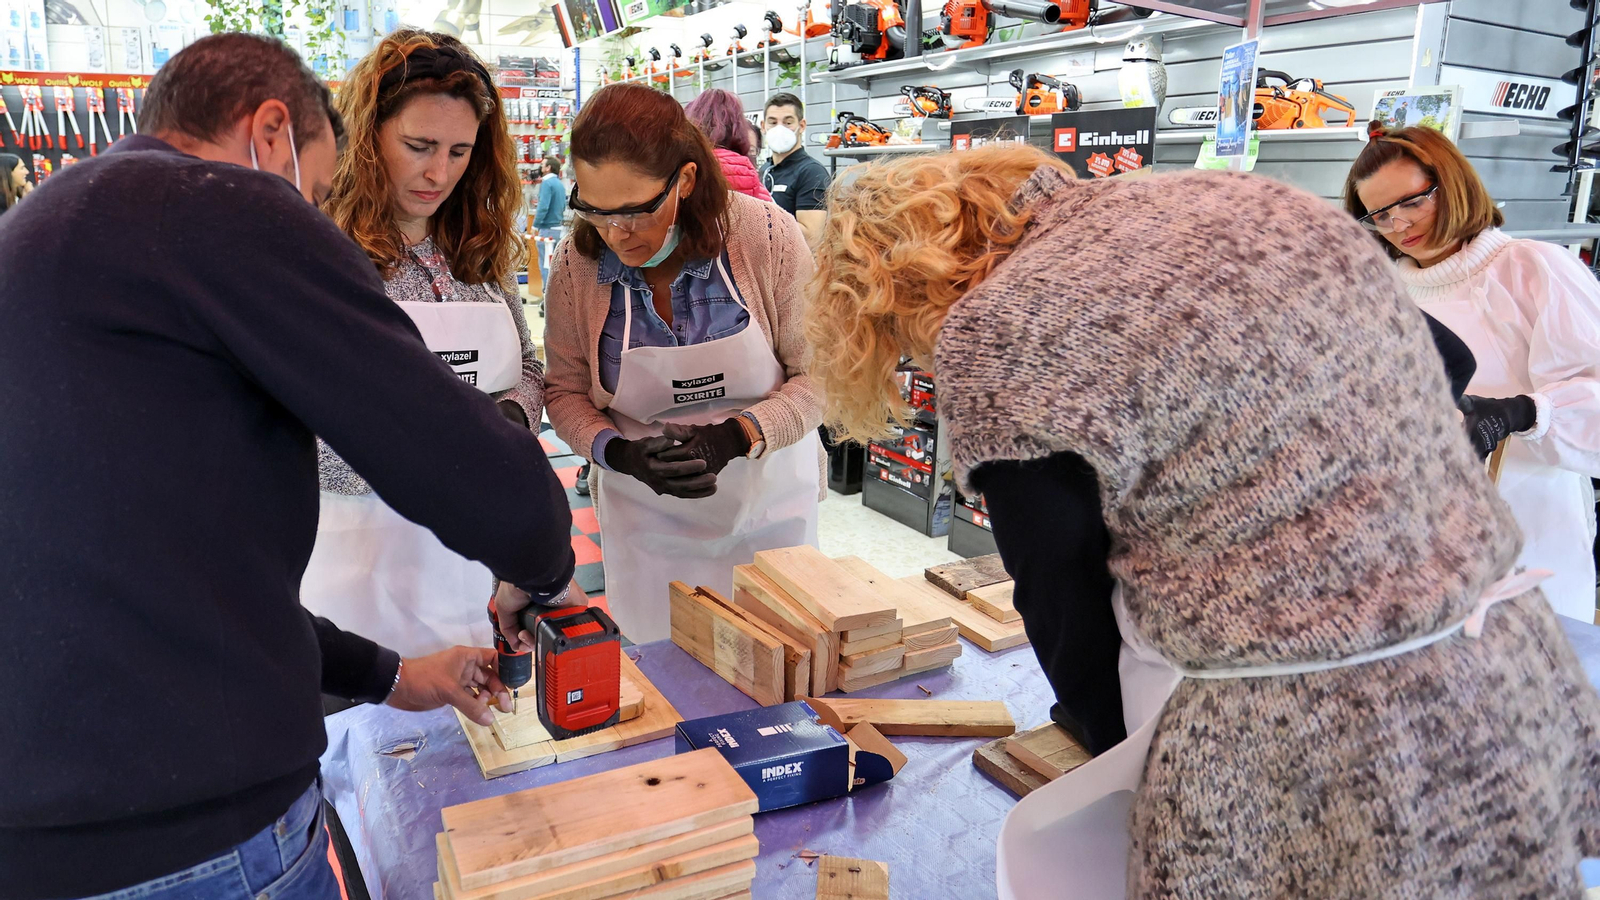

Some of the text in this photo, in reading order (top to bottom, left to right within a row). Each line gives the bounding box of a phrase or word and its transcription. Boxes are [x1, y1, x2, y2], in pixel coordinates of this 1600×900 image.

[14, 77, 39, 85] WOLF
[1503, 82, 1551, 111] ECHO
[989, 100, 1013, 108] ECHO
[1197, 111, 1218, 121] EC
[1078, 129, 1150, 147] Einhell
[441, 351, 472, 363] xylazel
[681, 375, 716, 388] xylazel
[676, 388, 723, 402] OXIRITE
[716, 728, 740, 748] INDEX
[761, 761, 802, 780] INDEX
